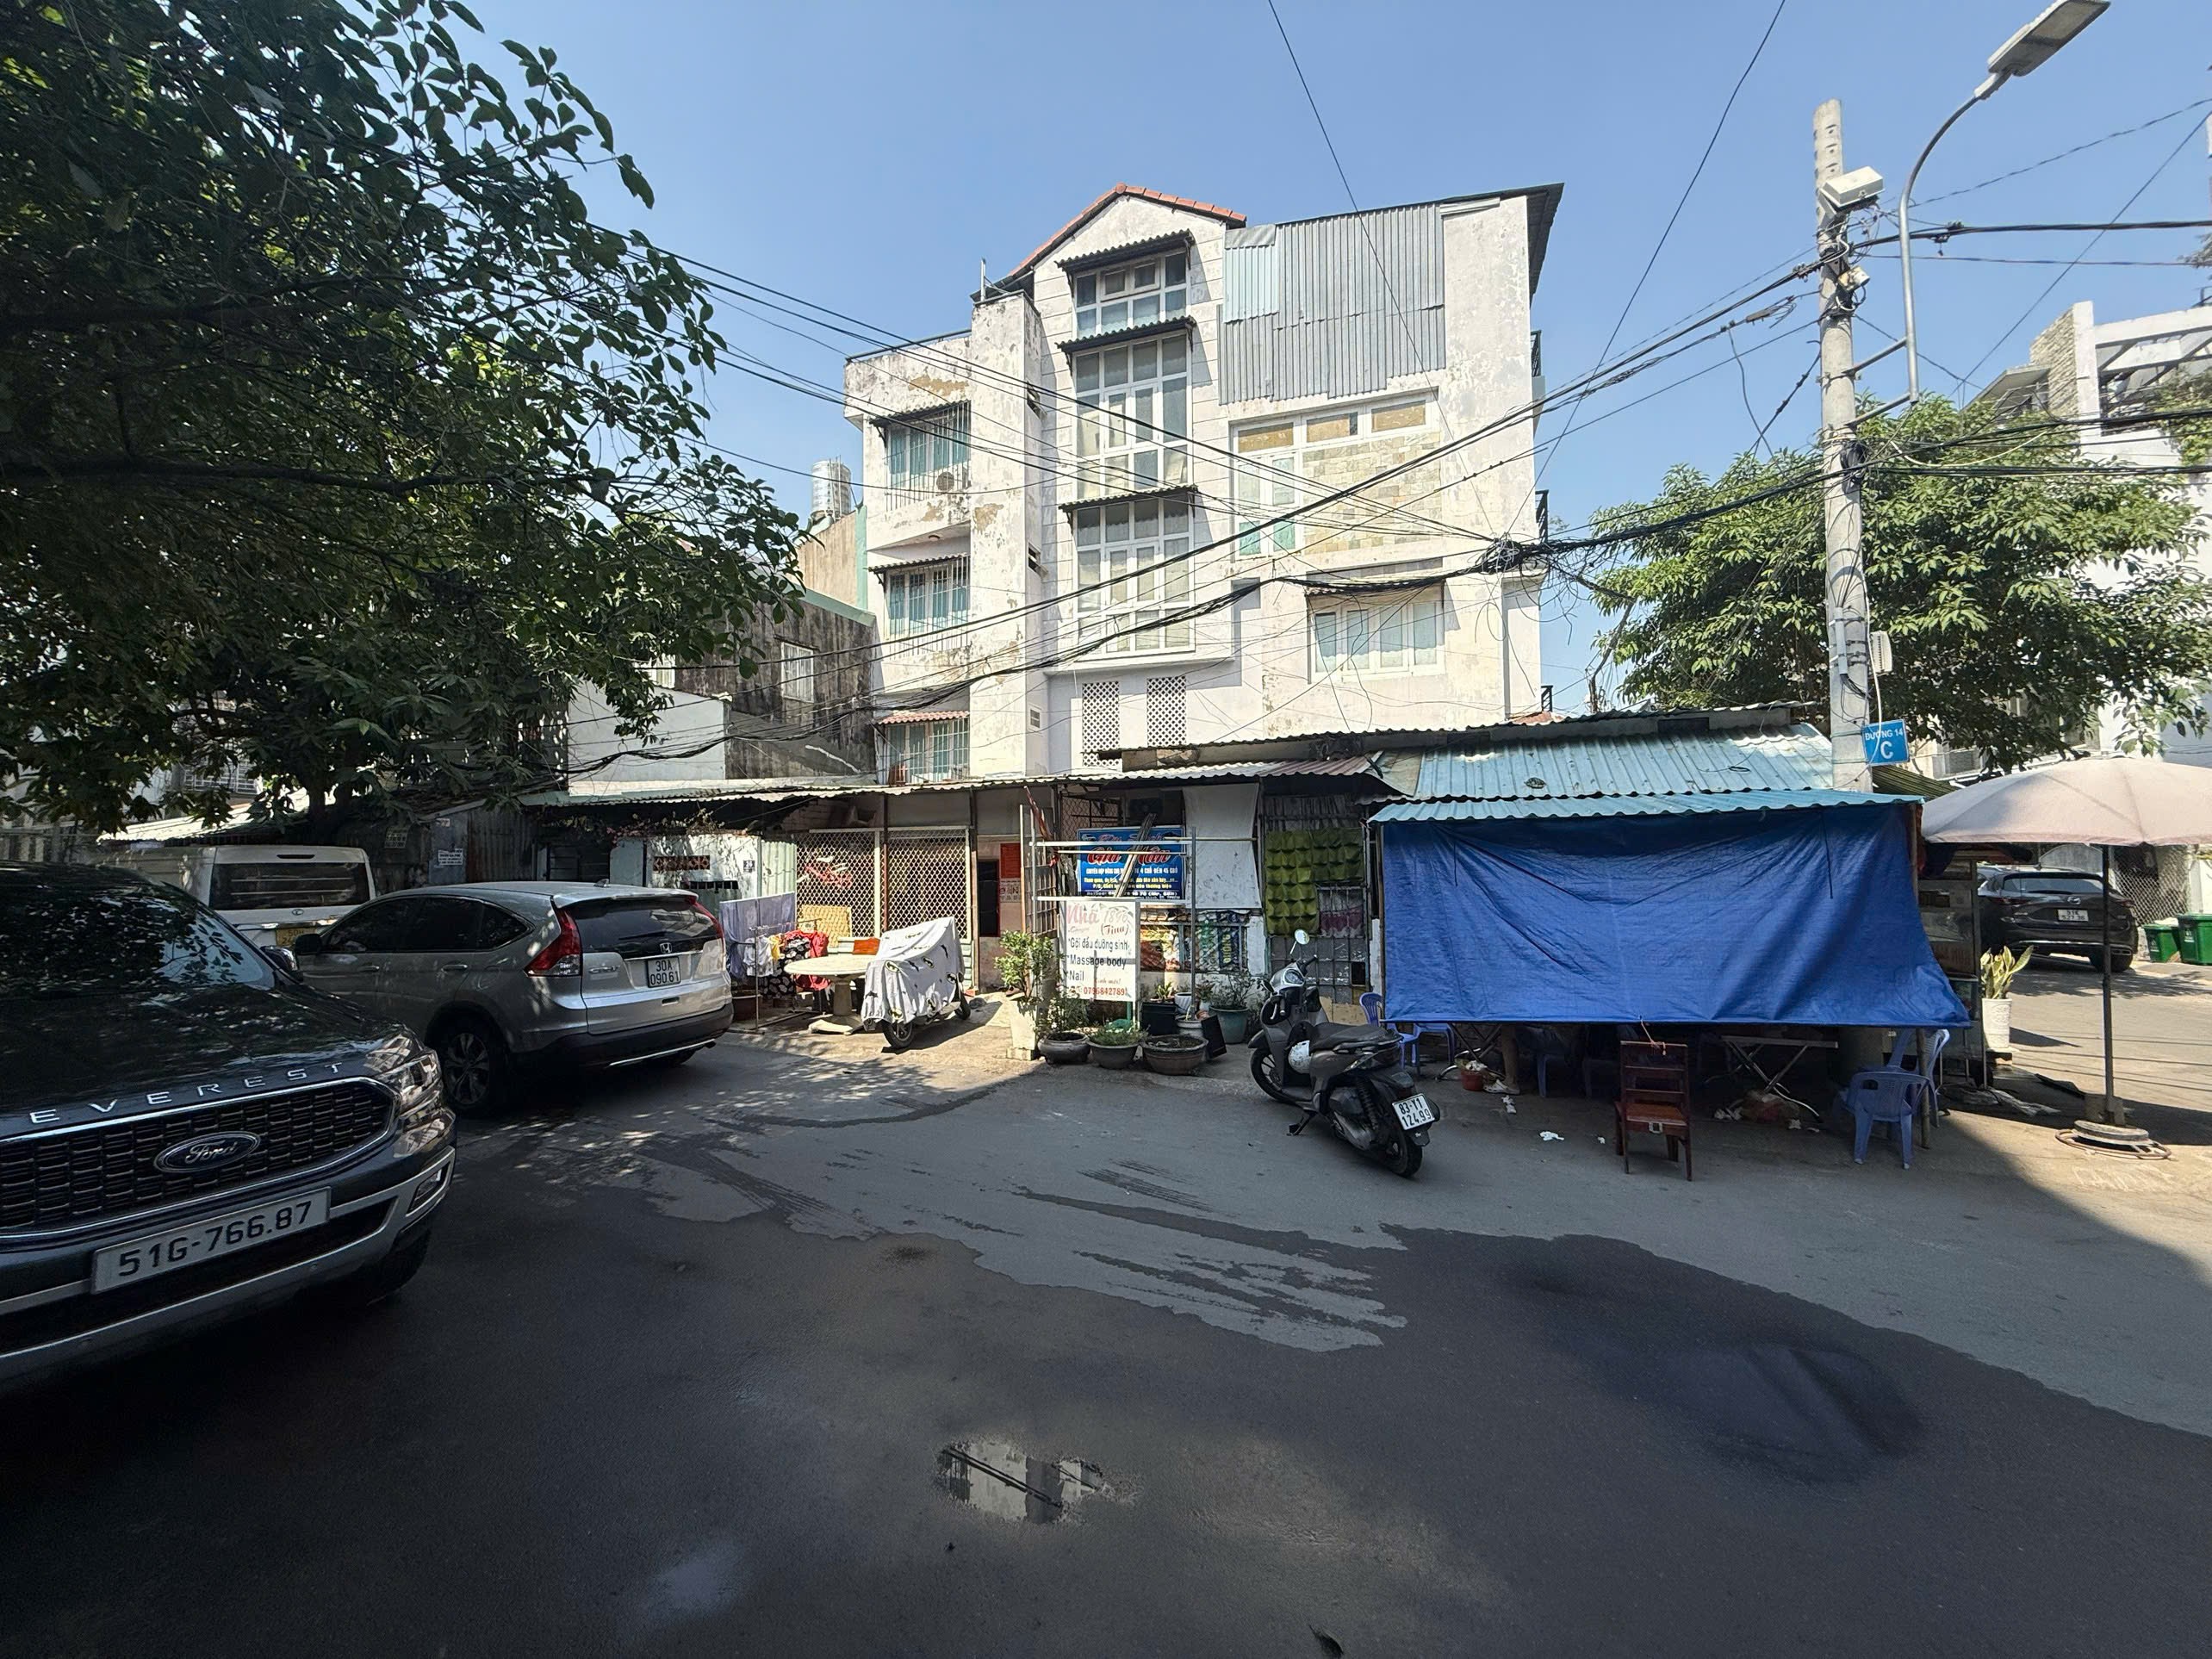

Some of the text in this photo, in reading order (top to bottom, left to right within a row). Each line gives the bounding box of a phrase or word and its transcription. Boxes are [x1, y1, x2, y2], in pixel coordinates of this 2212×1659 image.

[1894, 727, 1904, 737] 14
[1880, 740, 1894, 760] C
[1115, 940, 1128, 950] sinh
[655, 959, 673, 972] 30A
[1070, 954, 1127, 970] Massage body
[1069, 970, 1084, 981] Nail
[28, 1061, 344, 1125] EVEREST
[1401, 1108, 1432, 1128] 124.99
[184, 1140, 239, 1165] Ford
[118, 1200, 314, 1278] 51G-766.87
